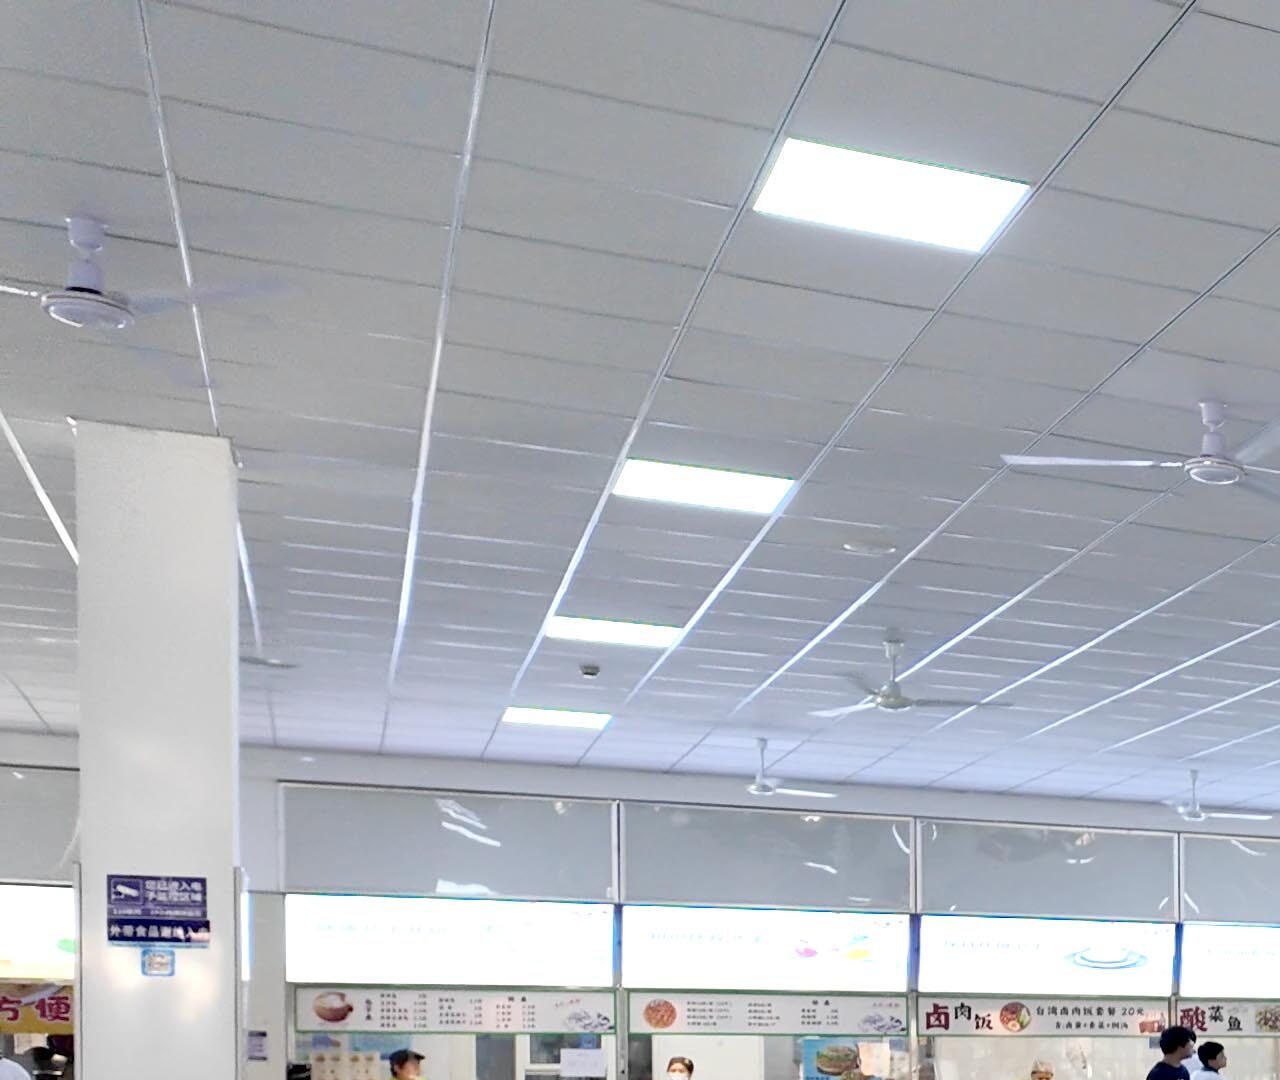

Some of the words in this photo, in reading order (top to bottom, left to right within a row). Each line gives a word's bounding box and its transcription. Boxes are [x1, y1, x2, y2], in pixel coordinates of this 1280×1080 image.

[926, 1002, 993, 1030] 卤肉饭
[1180, 1005, 1242, 1031] 酸菜鱼
